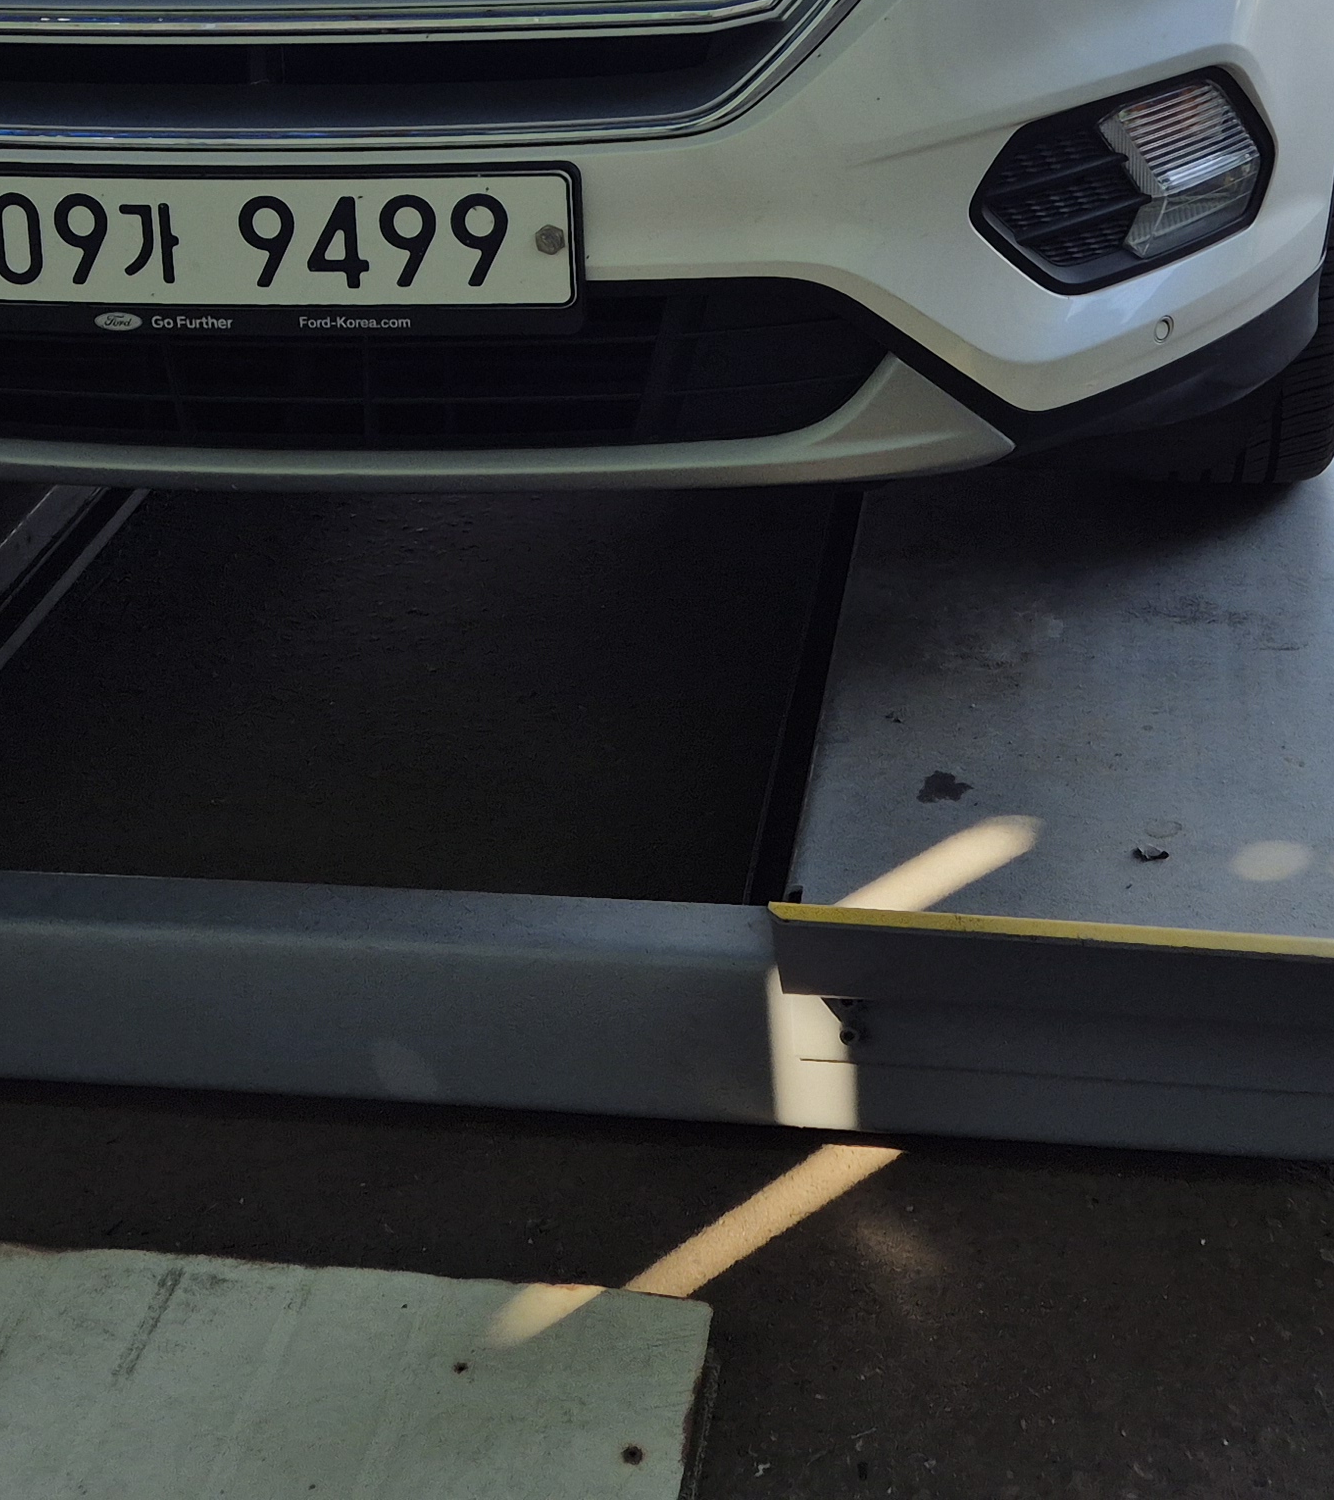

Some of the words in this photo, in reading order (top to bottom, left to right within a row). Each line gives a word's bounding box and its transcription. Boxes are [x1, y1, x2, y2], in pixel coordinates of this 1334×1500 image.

[237, 193, 509, 289] 9499
[103, 314, 132, 328] Ford
[151, 315, 174, 329] Go
[176, 315, 233, 329] Further
[299, 315, 411, 329] Ford-Korea.com
